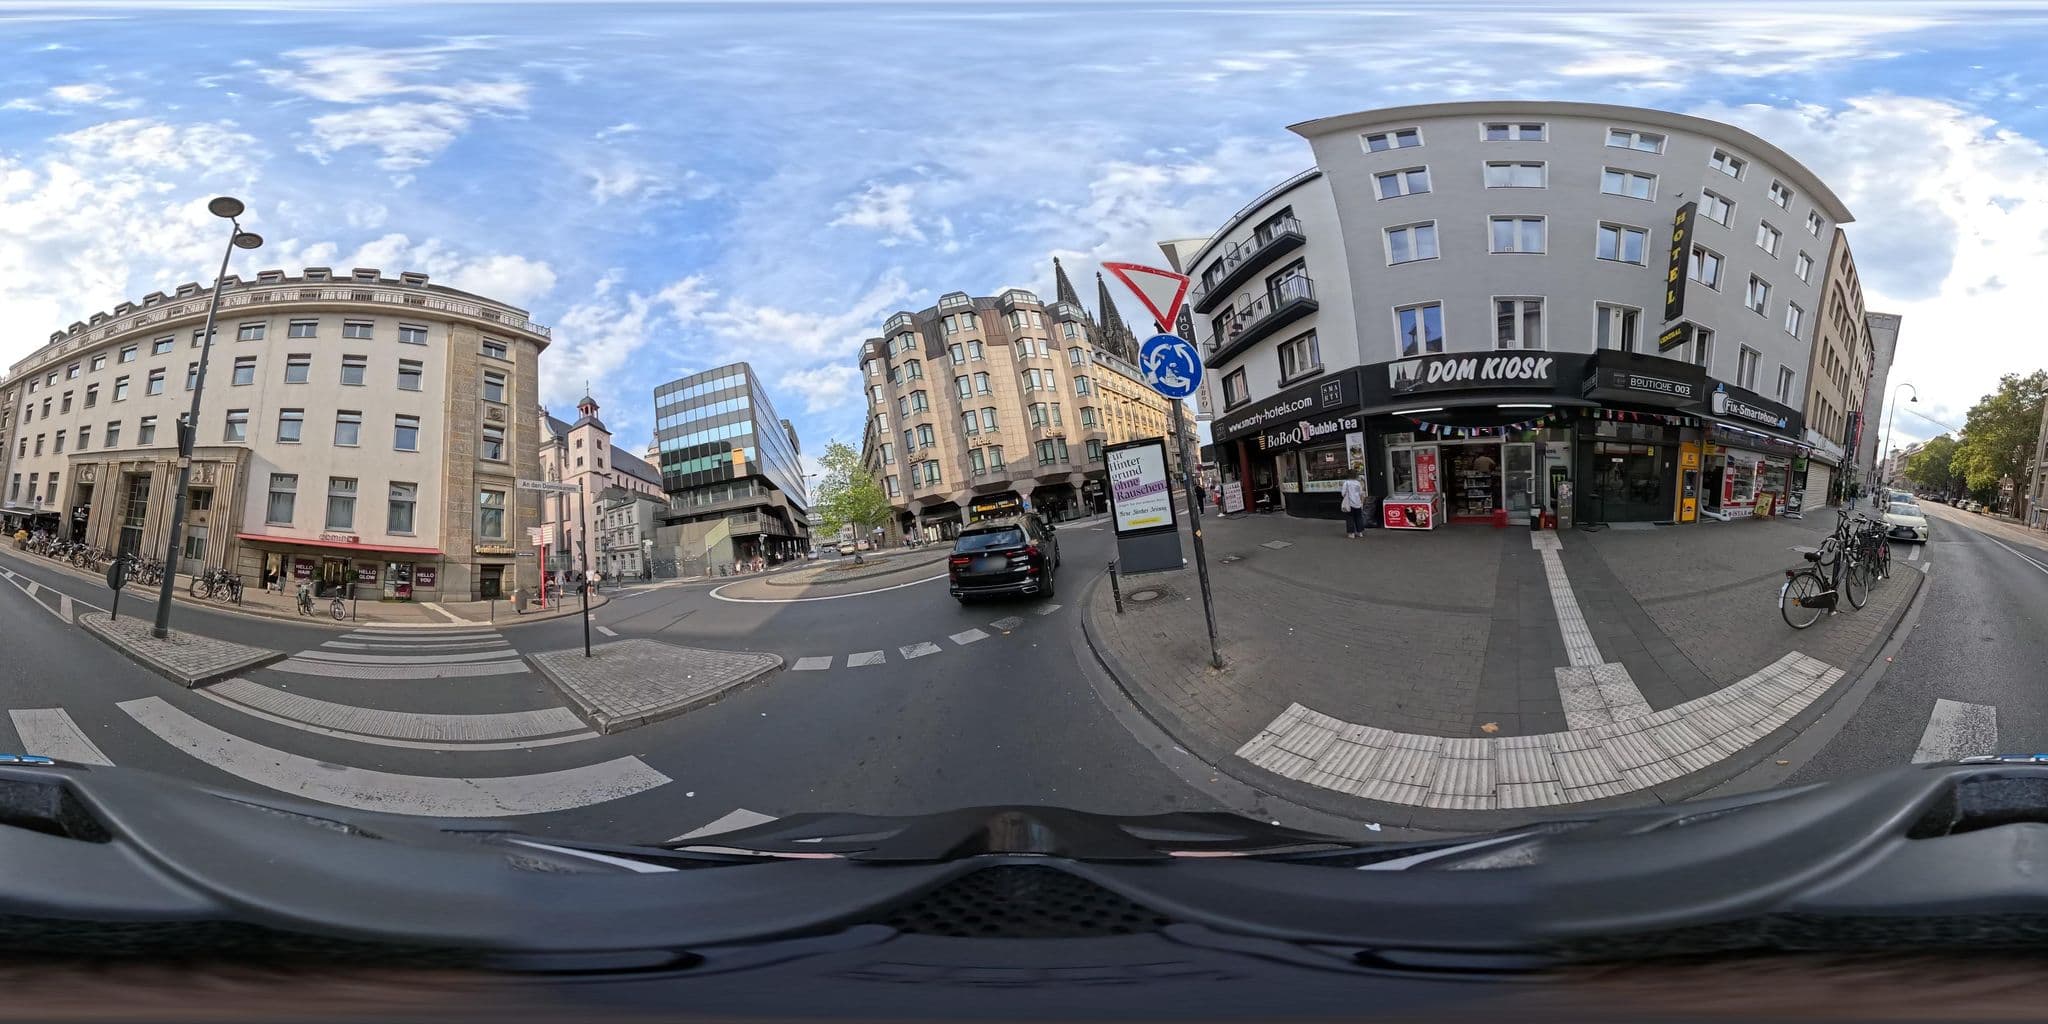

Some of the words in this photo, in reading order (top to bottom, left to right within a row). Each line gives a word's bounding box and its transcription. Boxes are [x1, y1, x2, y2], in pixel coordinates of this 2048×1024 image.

[1667, 211, 1687, 305] HOTEL
[1427, 358, 1477, 384] DOM
[1481, 356, 1553, 380] KIOSK
[1674, 384, 1690, 395] 003
[1228, 397, 1313, 433] www.smarty-hotels.com
[1308, 420, 1338, 437] Bubble
[1338, 418, 1358, 431] Tea
[1267, 427, 1302, 448] BoBoQ
[1109, 456, 1141, 472] Hinter
[1111, 465, 1143, 482] grund
[1114, 477, 1140, 491] ohne
[1116, 482, 1168, 501] Rauschen.
[358, 568, 377, 576] HELLO
